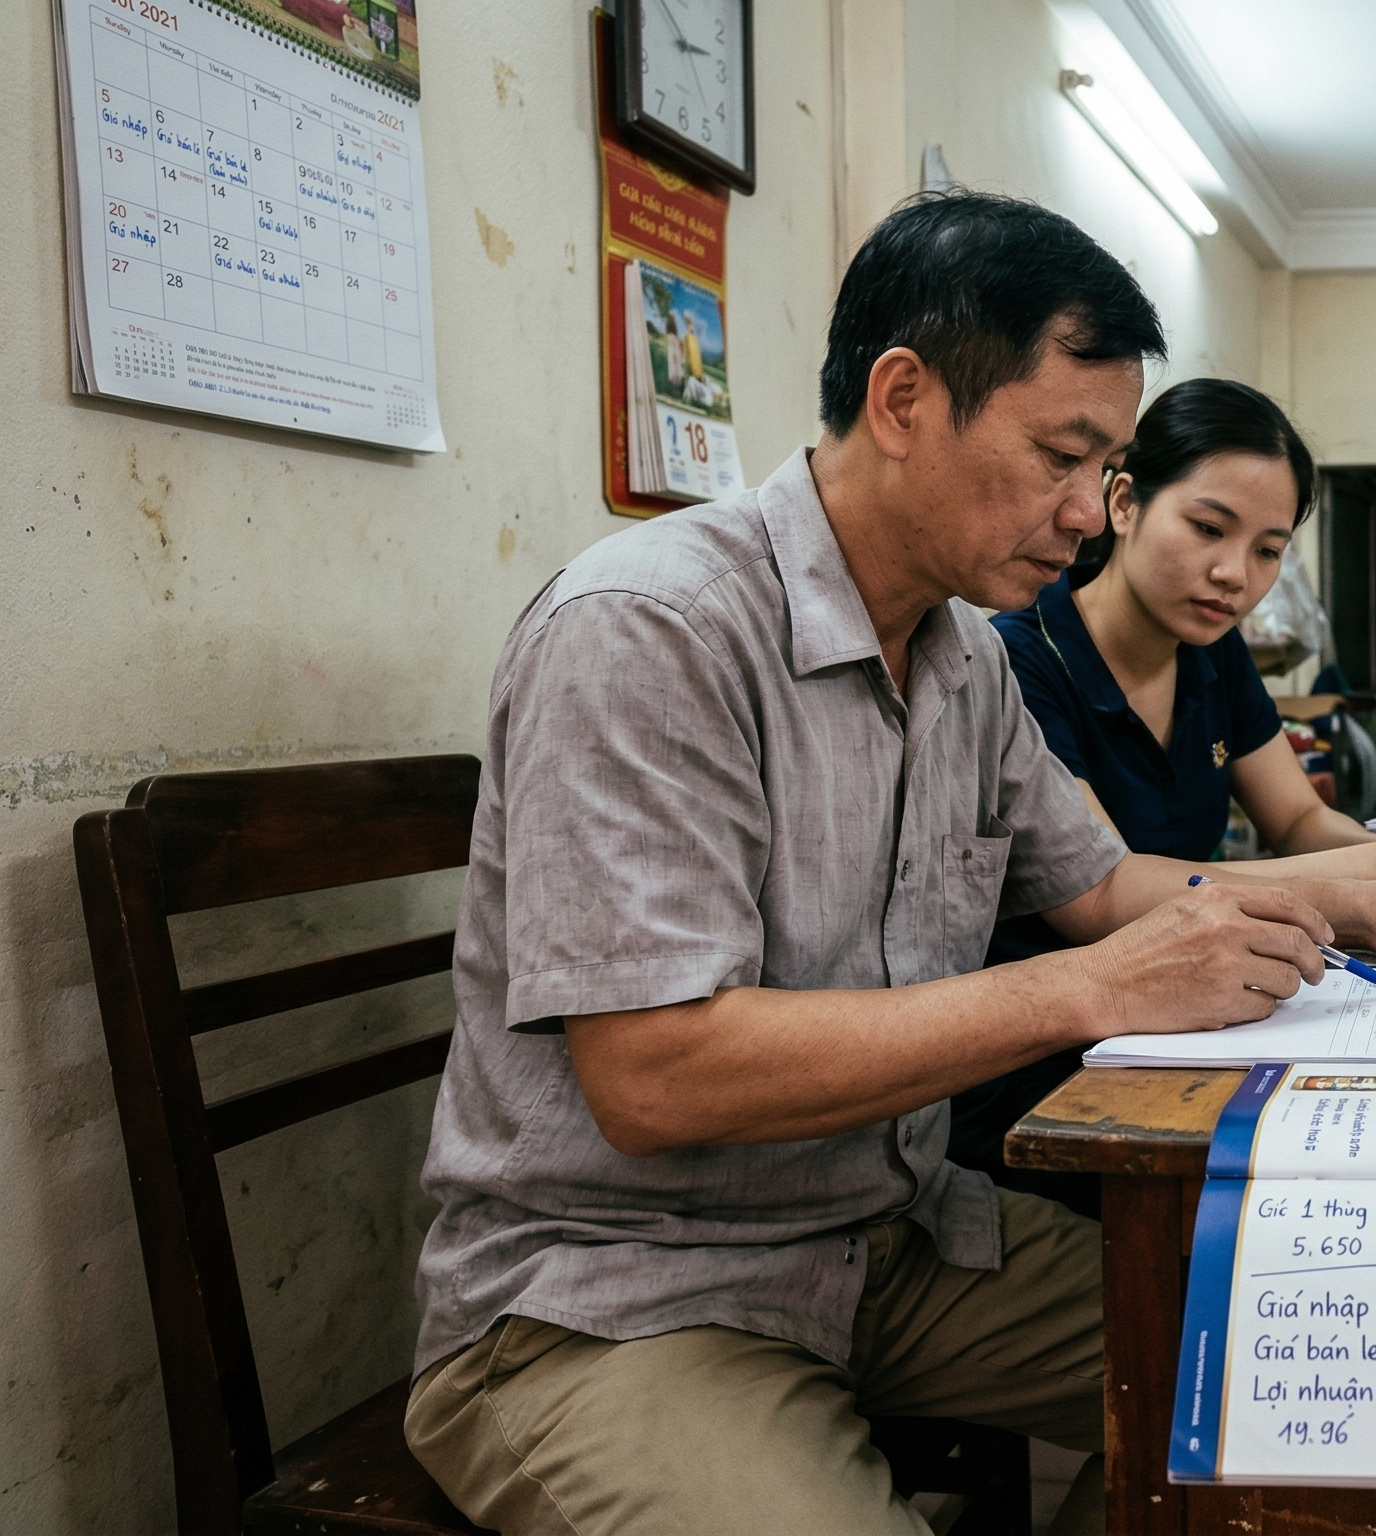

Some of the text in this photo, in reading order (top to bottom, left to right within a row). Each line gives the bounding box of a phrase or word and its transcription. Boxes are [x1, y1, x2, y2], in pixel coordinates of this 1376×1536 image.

[140, 0, 178, 31] 2021
[714, 18, 725, 45] 2
[716, 59, 727, 84] 3
[101, 88, 111, 103] 5
[655, 88, 666, 115] 7
[251, 98, 258, 111] 1
[715, 101, 726, 124] 4
[155, 109, 165, 124] 6
[295, 117, 303, 130] 2
[206, 129, 215, 142] 7
[701, 117, 712, 143] 5
[336, 133, 344, 147] 3
[106, 146, 124, 163] 13
[253, 148, 262, 161] 8
[376, 151, 383, 162] 4
[161, 166, 177, 182] 14
[298, 165, 306, 178] 9
[211, 184, 226, 199] 14
[340, 181, 353, 196] 10
[109, 202, 127, 219] 20
[258, 200, 273, 214] 15
[380, 197, 393, 211] 12
[163, 219, 179, 236] 21
[303, 215, 317, 230] 16
[213, 235, 229, 251] 22
[344, 229, 357, 244] 17
[260, 249, 276, 265] 23
[111, 258, 129, 274] 27
[304, 263, 319, 278] 25
[166, 273, 184, 289] 28
[346, 275, 360, 290] 24
[684, 421, 709, 464] 18
[1301, 1198, 1314, 1218] 1
[1257, 1290, 1369, 1329] Giá nhập
[1254, 1333, 1300, 1361] Giá
[1306, 1333, 1350, 1361] bán
[1253, 1373, 1374, 1410] Lợi nhuận
